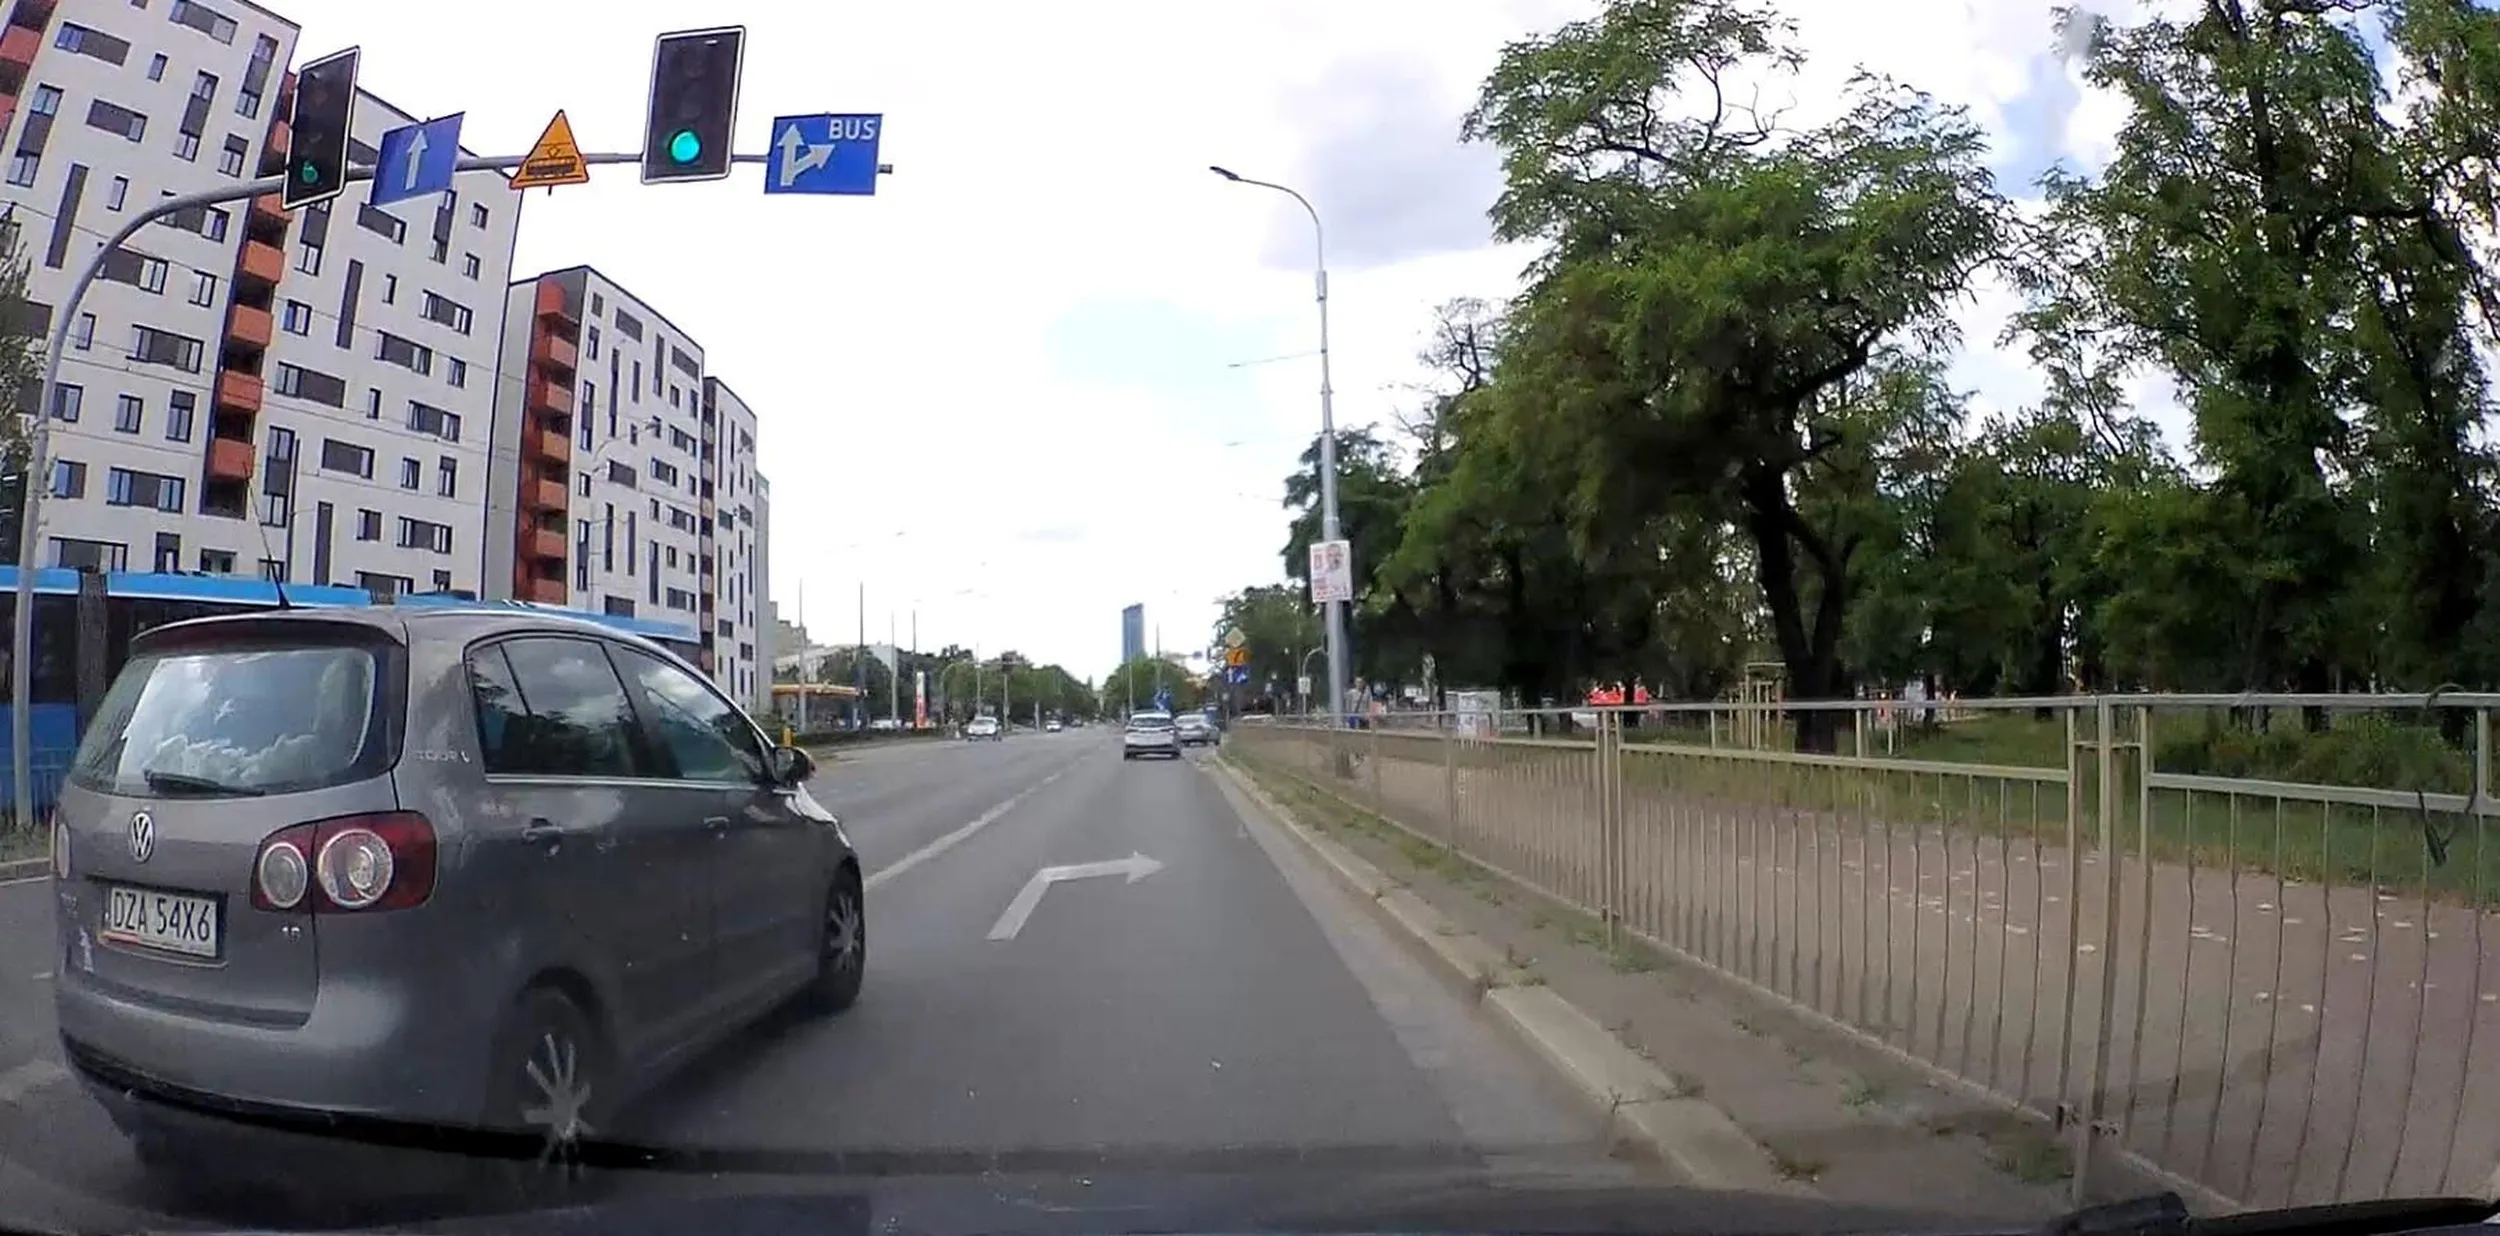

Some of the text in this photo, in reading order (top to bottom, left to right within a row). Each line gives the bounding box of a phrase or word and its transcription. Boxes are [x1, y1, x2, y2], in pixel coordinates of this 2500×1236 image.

[829, 119, 876, 140] BUS
[114, 892, 149, 932] DZA
[157, 898, 211, 942] 54X6
